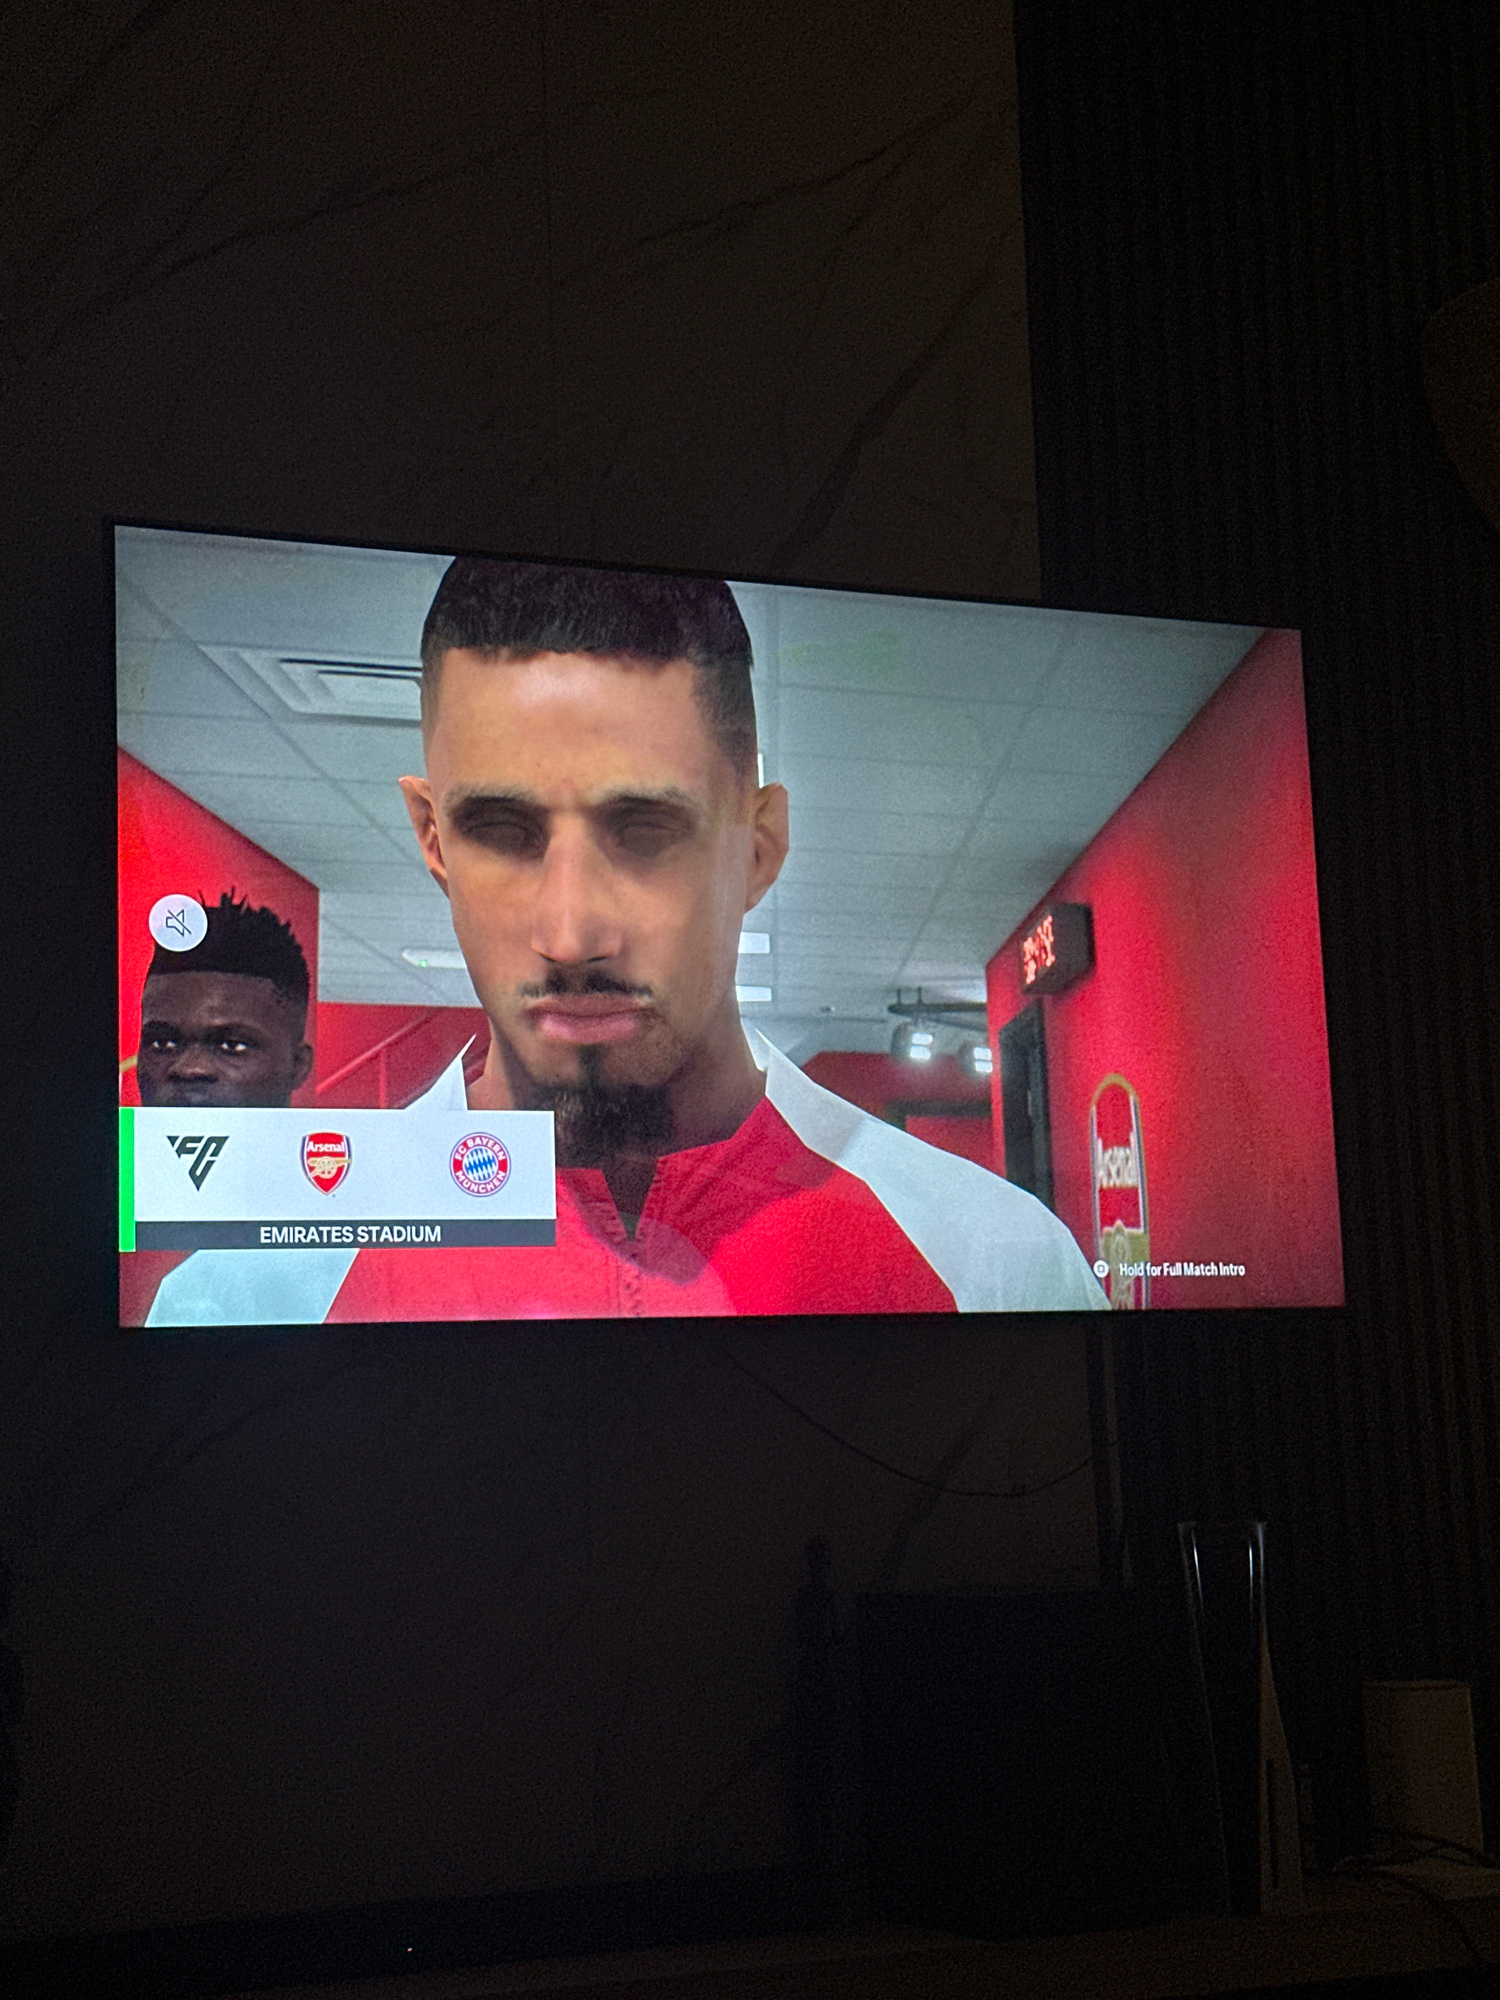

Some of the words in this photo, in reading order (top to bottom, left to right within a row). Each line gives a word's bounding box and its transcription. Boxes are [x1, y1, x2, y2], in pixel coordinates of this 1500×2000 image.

[307, 1141, 345, 1152] Arsenal
[454, 1145, 467, 1161] FC
[466, 1137, 506, 1161] BAYERN
[260, 1226, 353, 1244] EMIRATES
[357, 1225, 441, 1242] STADIUM
[1119, 1263, 1144, 1276] Hold
[1146, 1262, 1162, 1276] for
[1163, 1262, 1182, 1276] Full
[1184, 1262, 1218, 1276] Match
[1220, 1262, 1246, 1276] Intro
